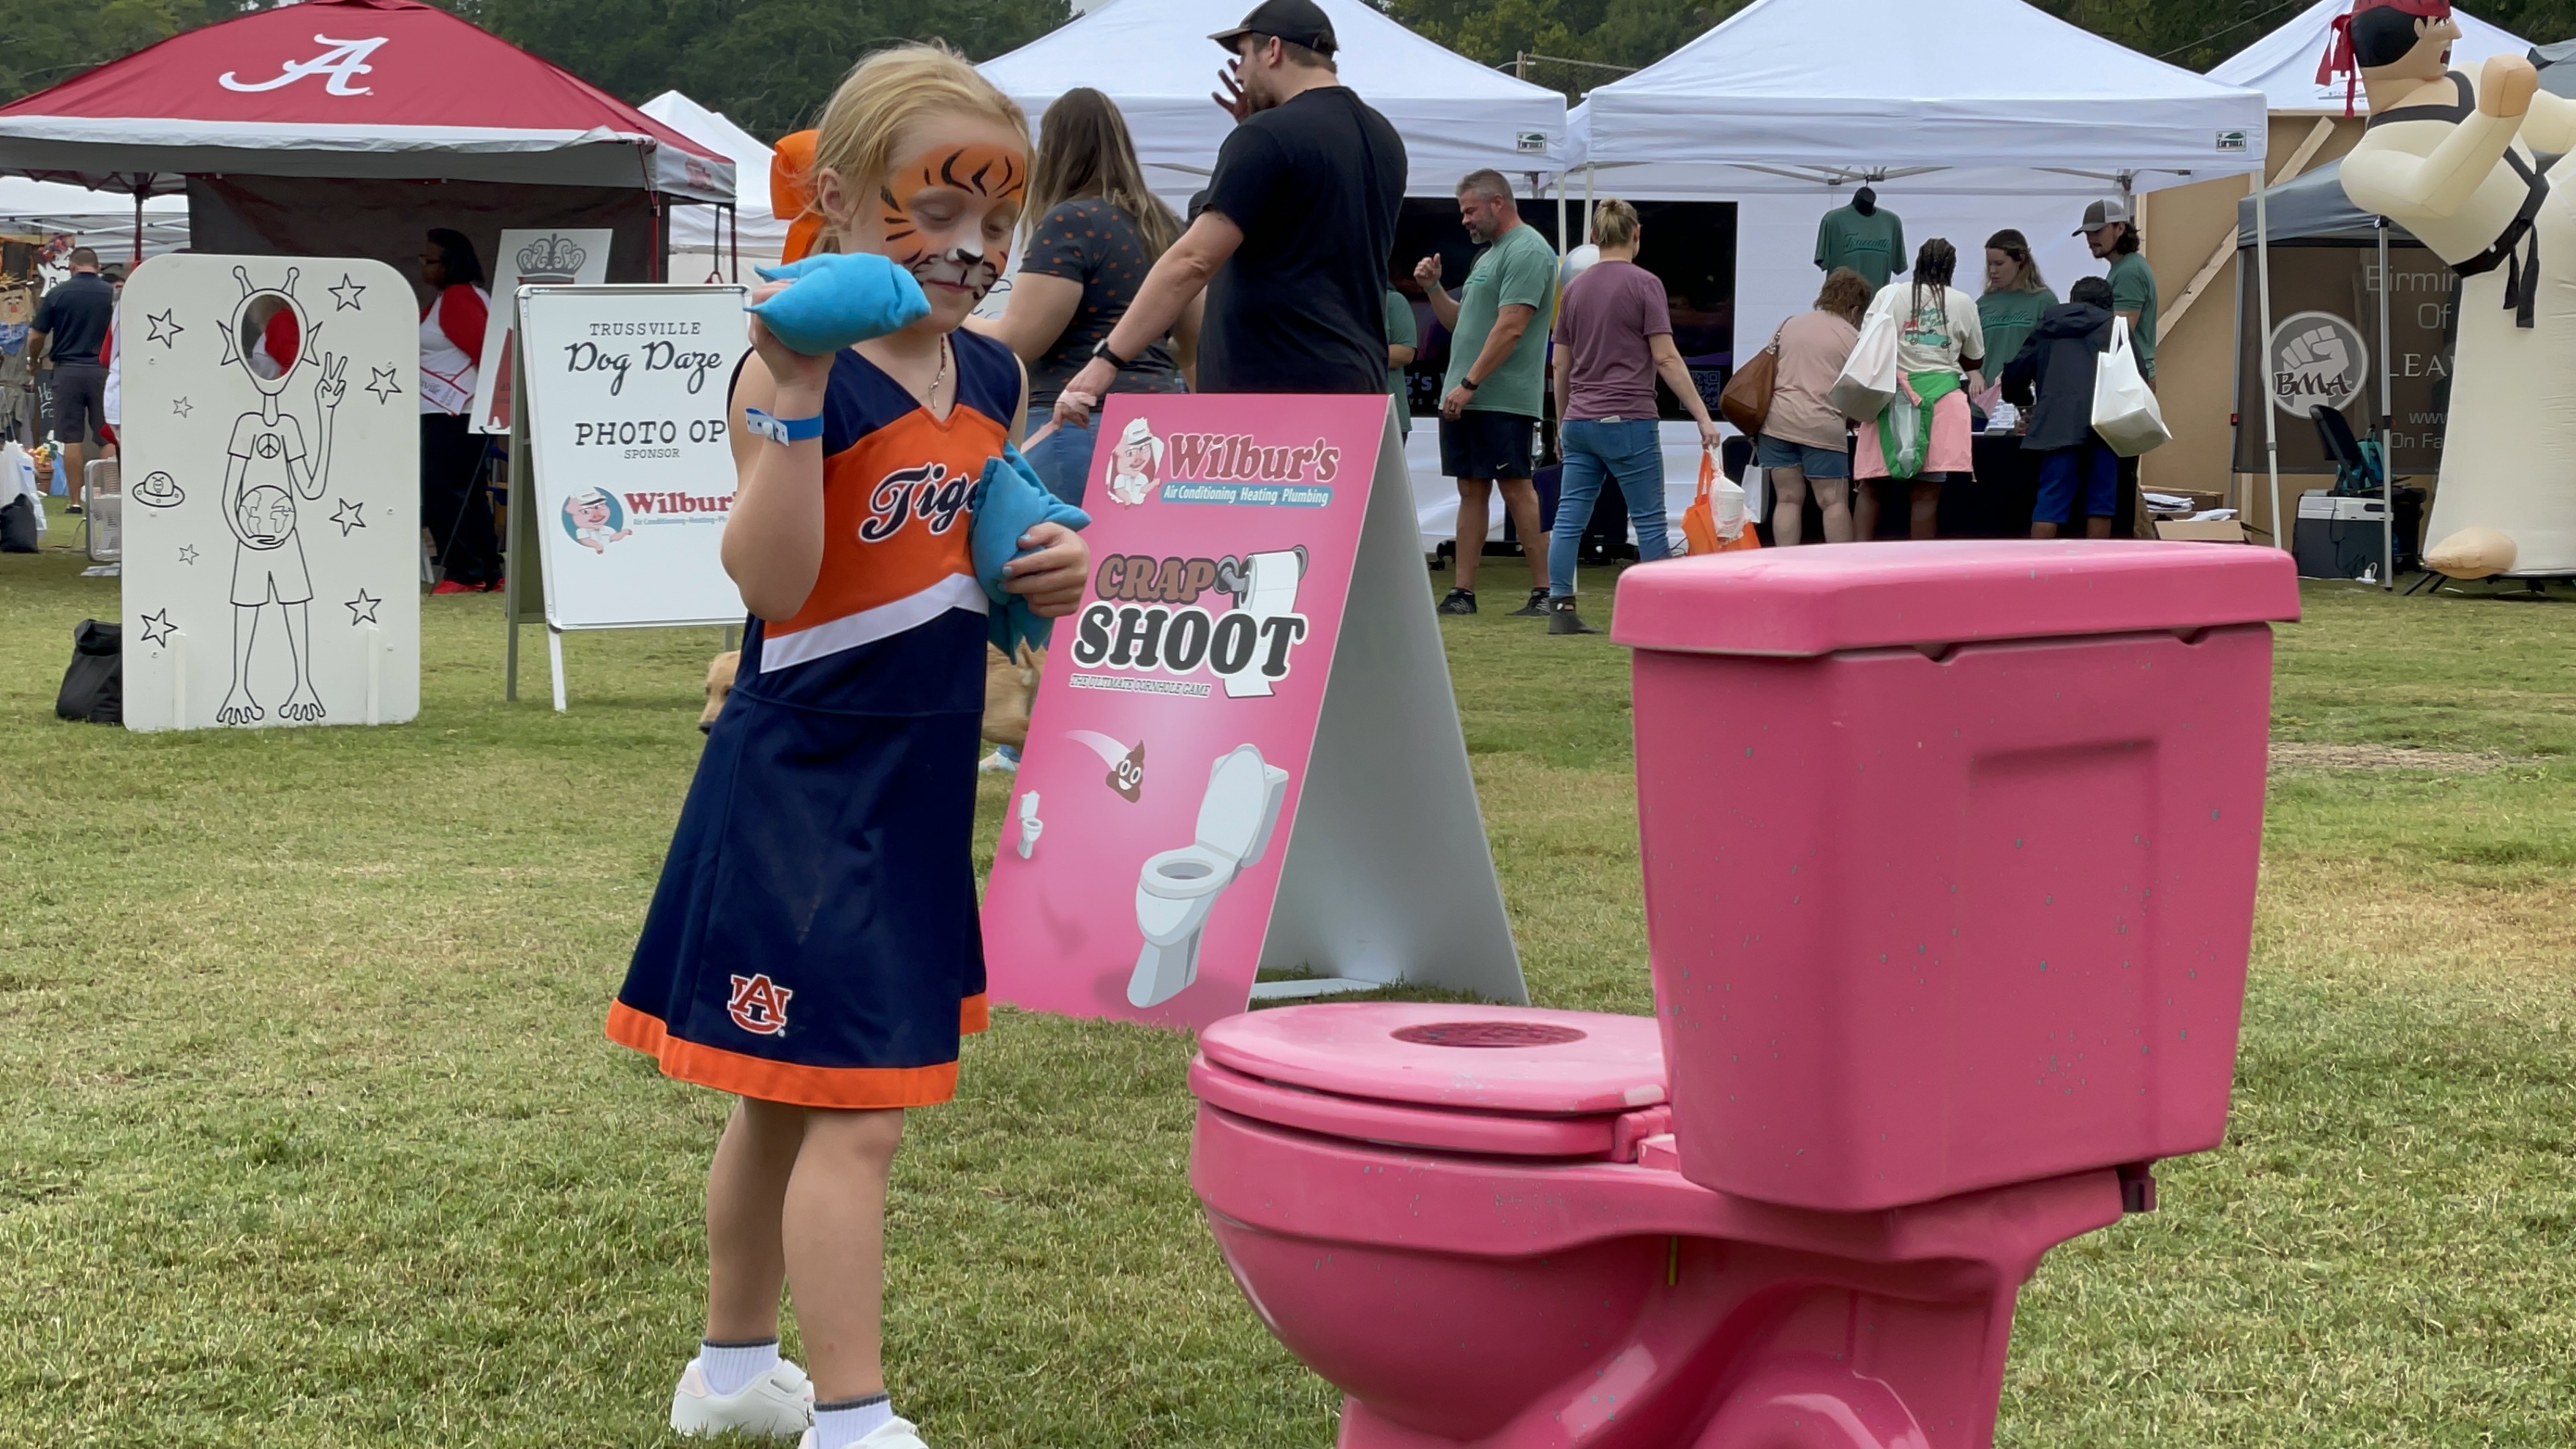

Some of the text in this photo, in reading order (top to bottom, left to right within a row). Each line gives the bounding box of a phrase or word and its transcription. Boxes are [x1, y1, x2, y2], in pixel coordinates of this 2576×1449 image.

[2418, 303, 2452, 329] Of
[589, 322, 701, 336] TRUSSVILLE
[564, 340, 722, 396] Dog Daze
[2274, 372, 2353, 396] BMA
[574, 420, 727, 446] PHOTO OP
[2390, 432, 2414, 448] On
[624, 449, 680, 459] SPONSOR
[1169, 433, 1340, 482] Wilbur's
[1164, 484, 1329, 506] Air Conditioning Heating Plumbing
[1096, 554, 1218, 604] CRAP
[1074, 604, 1306, 677] SHOOT
[1070, 675, 1211, 696] THE ULTIMATE CORNHOLE GAME
